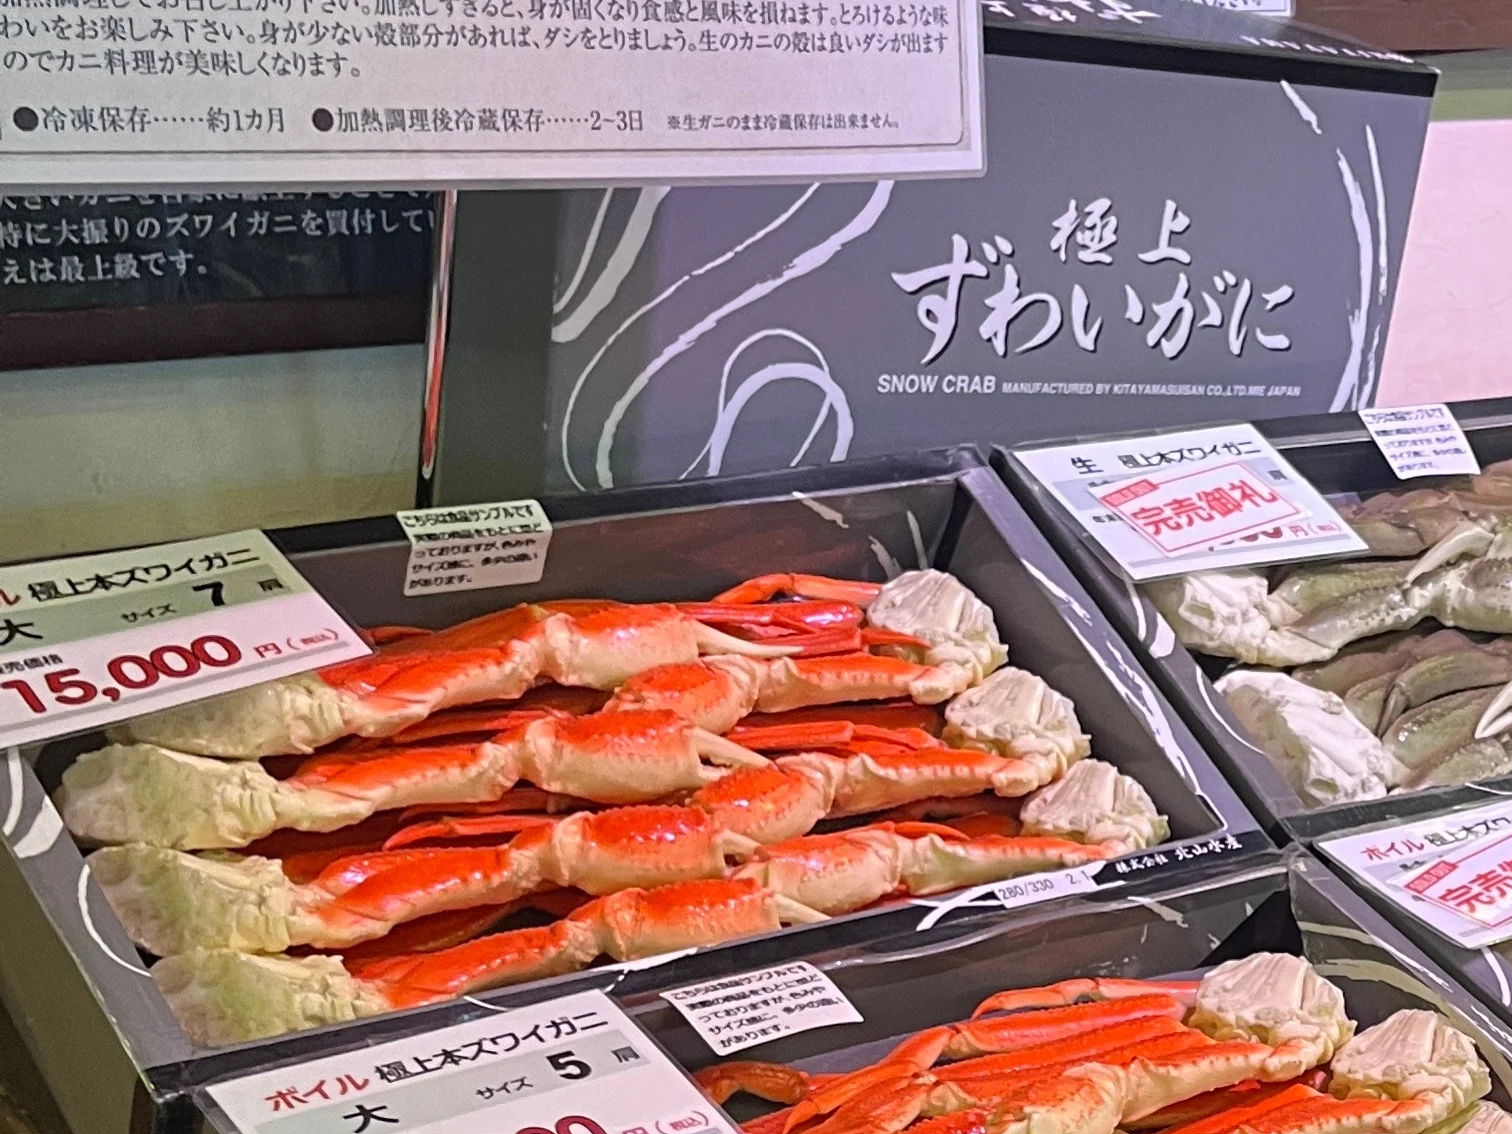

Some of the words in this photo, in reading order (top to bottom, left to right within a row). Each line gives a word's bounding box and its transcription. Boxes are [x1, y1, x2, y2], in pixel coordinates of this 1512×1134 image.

[3, 49, 361, 78] のでカニ料理が美味しくなります。
[1050, 198, 1192, 265] 極上
[891, 233, 1295, 366] ずわいがに
[877, 374, 939, 395] SNOW
[942, 373, 996, 395] CRAB
[1002, 381, 1096, 396] MANUFACTURED
[1096, 383, 1111, 396] BY
[1070, 456, 1105, 475] 生
[1129, 479, 1279, 537] 完売御礼
[0, 618, 44, 642] 大
[120, 602, 178, 624] サイズ
[192, 581, 226, 607] 7
[0, 634, 242, 714] 15,000
[1361, 838, 1425, 861] ボイル
[998, 876, 1055, 901] 280/330
[265, 1074, 370, 1112] ボイル
[375, 1010, 609, 1085] 極上本ズワイガニ
[343, 1104, 400, 1134] 大
[475, 1076, 534, 1100] サイズ
[546, 1050, 592, 1082] 5
